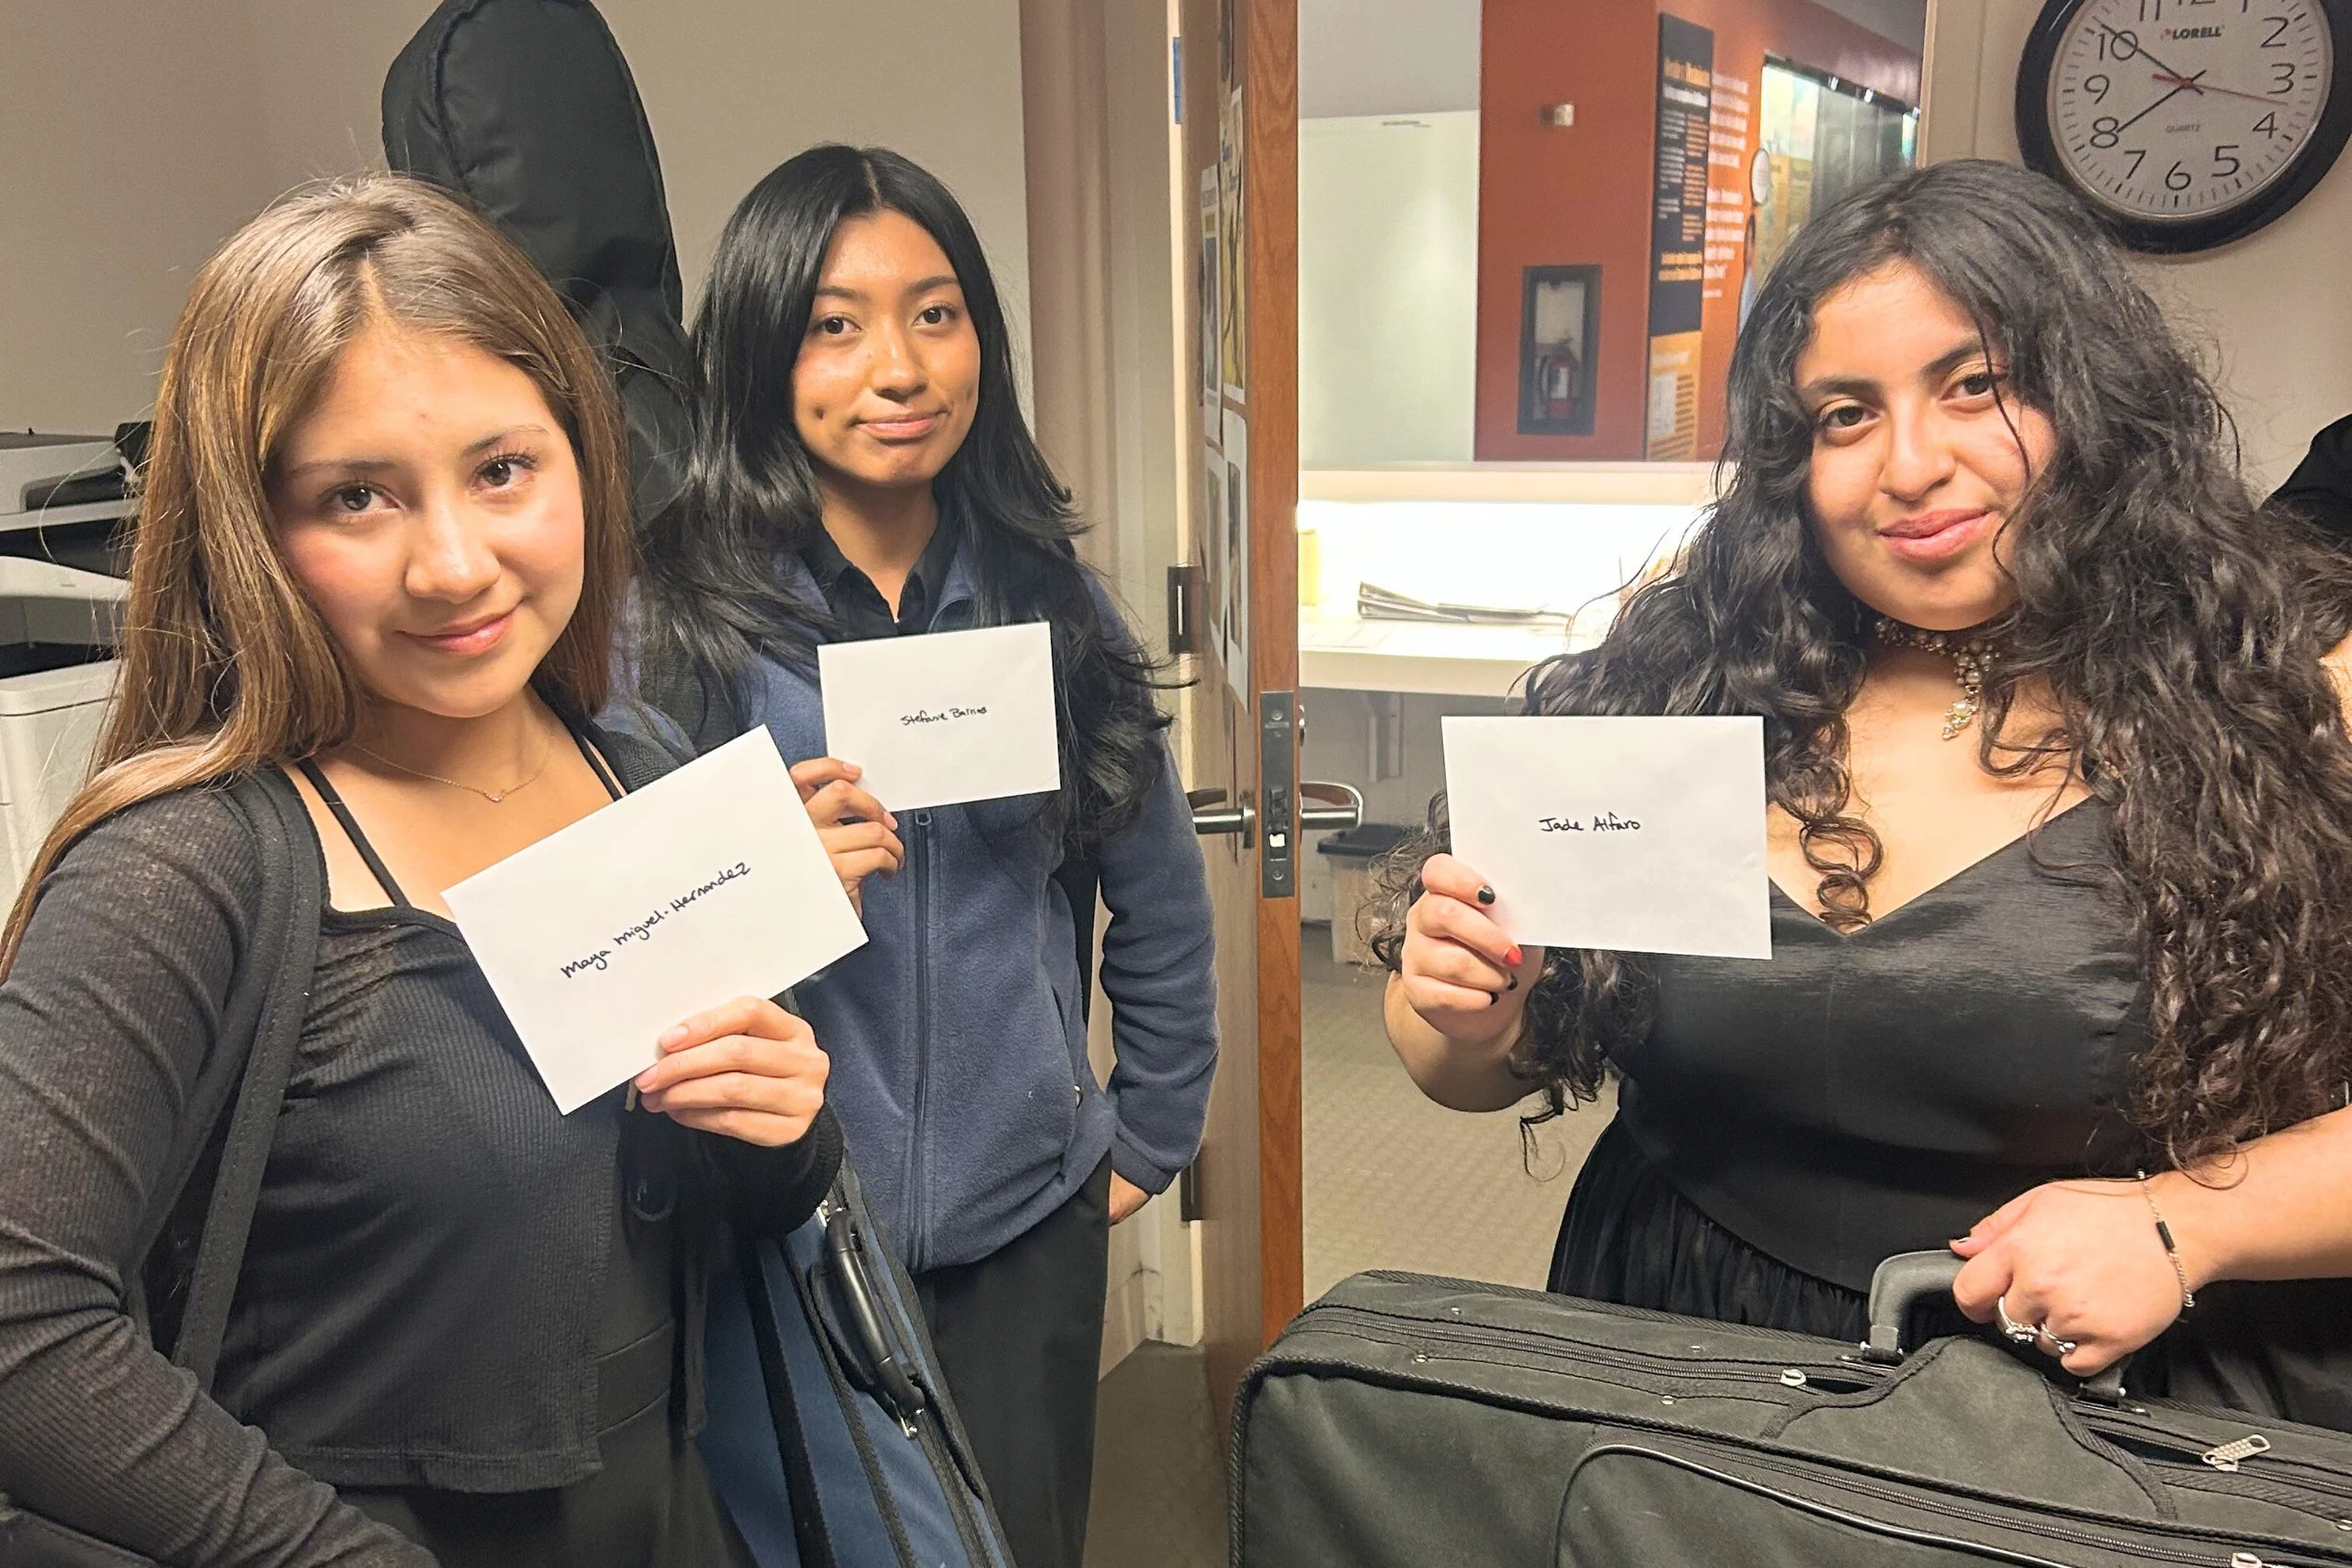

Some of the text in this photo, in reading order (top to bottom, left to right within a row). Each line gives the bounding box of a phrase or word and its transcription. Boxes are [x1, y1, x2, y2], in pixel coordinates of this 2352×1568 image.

[2097, 30, 2138, 61] 10
[2172, 26, 2222, 40] LORELL
[2260, 16, 2289, 48] 2
[2084, 74, 2110, 104] 9
[2266, 63, 2296, 95] 3
[2090, 117, 2120, 149] 8
[2252, 111, 2279, 139] 4
[2123, 150, 2147, 180] 7
[2165, 161, 2192, 191] 6
[2212, 145, 2240, 177] 5
[1538, 811, 1641, 832] Jade Alfaro
